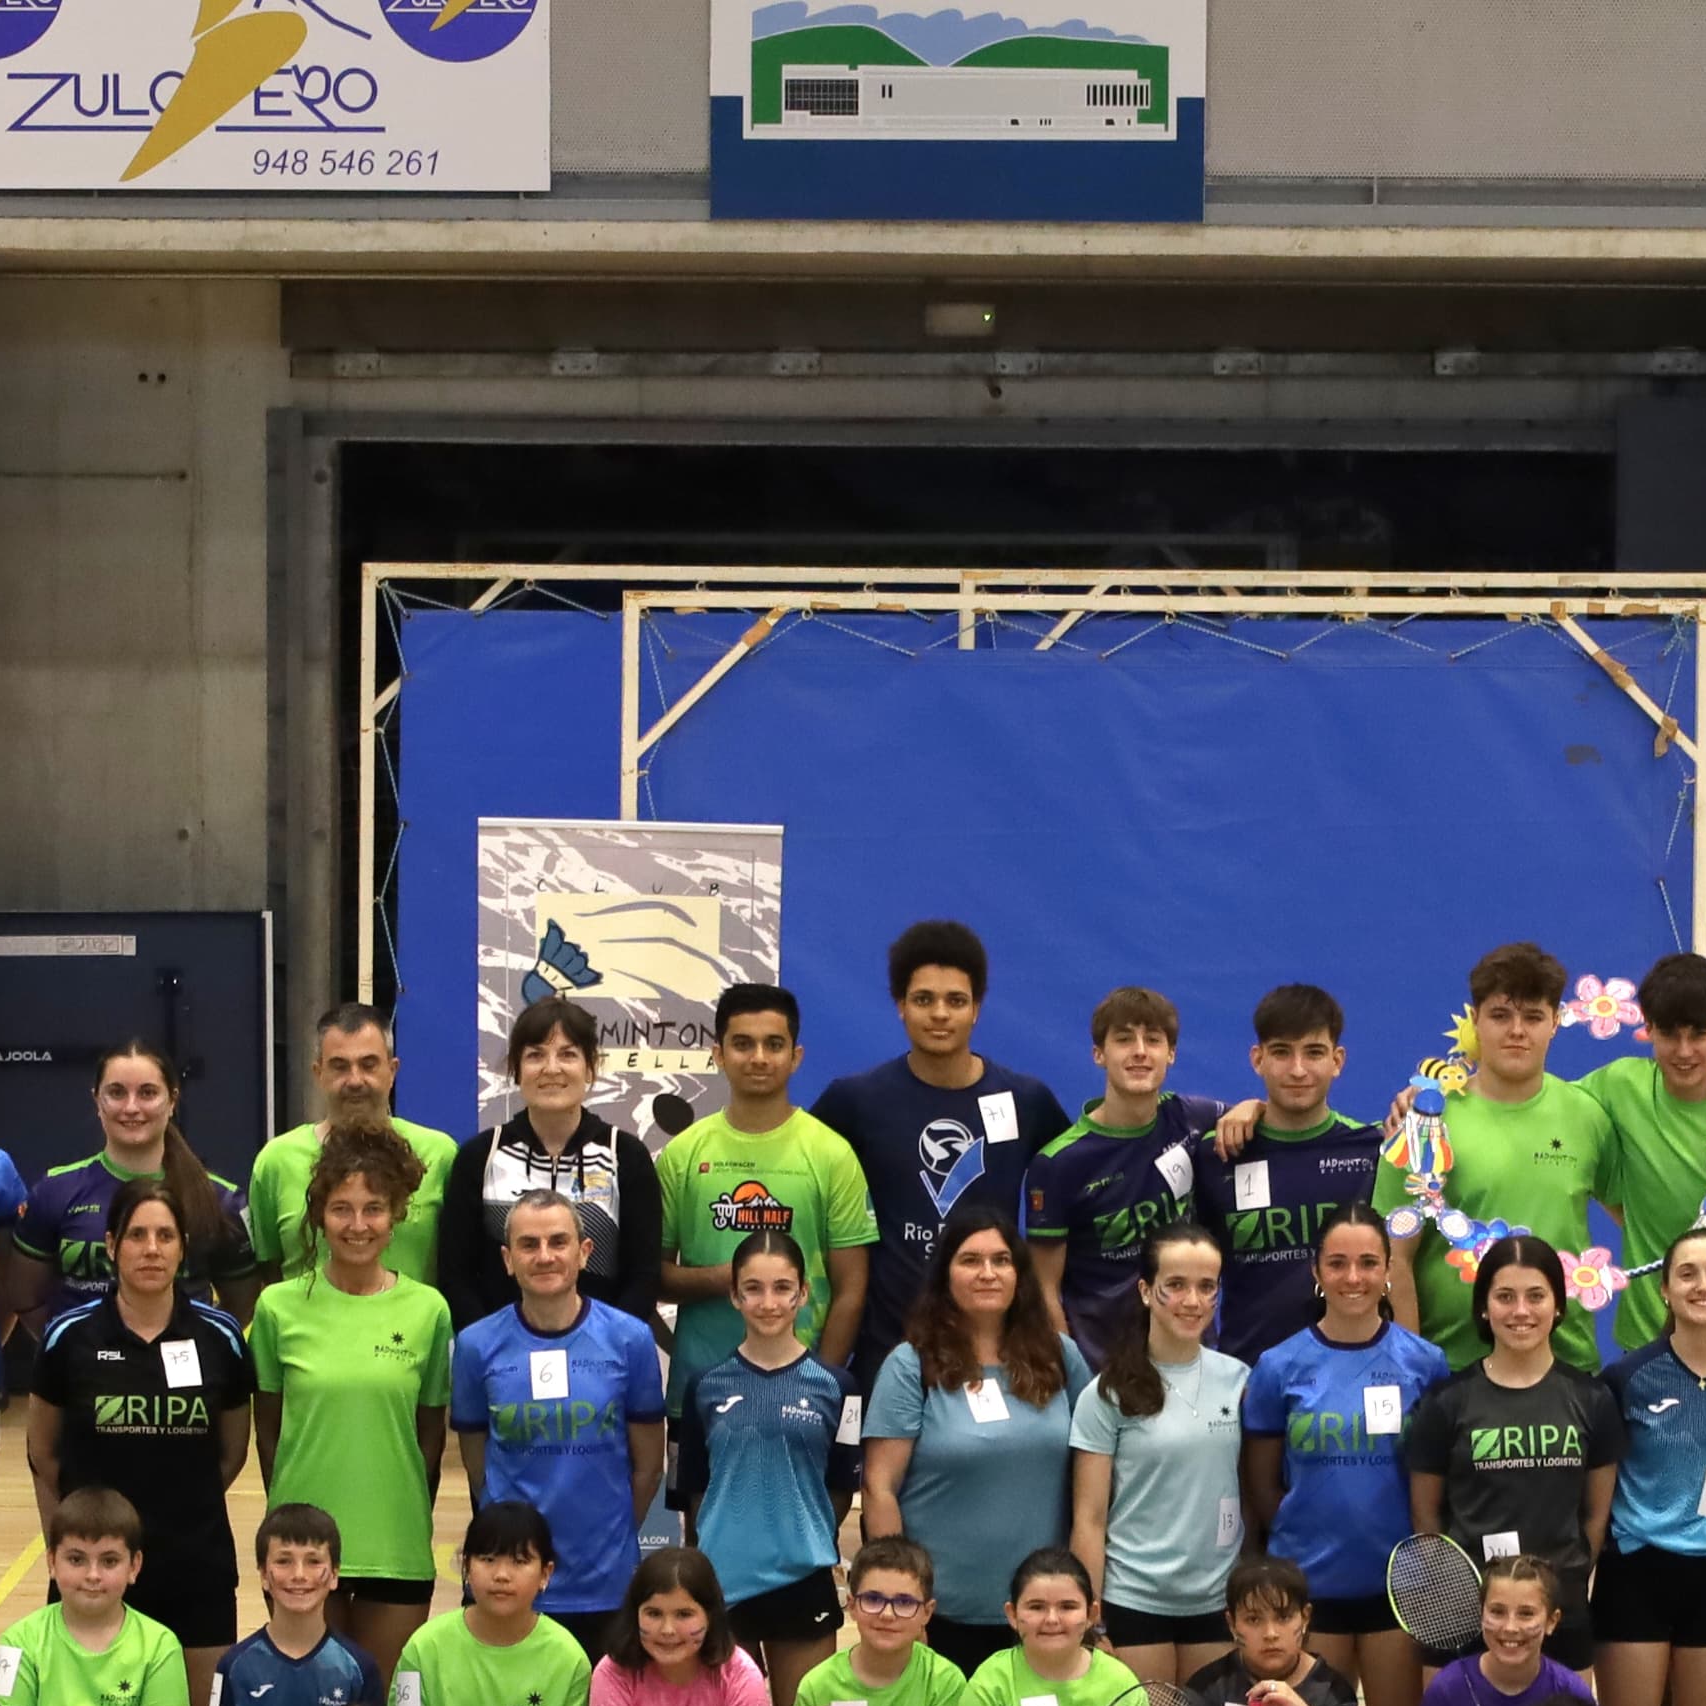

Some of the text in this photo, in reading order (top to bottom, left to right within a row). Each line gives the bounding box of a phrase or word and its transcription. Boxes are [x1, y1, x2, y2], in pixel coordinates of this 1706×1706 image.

[252, 148, 441, 176] 948 546 261
[537, 878, 720, 896] CLUB
[599, 1021, 718, 1048] MINTON
[5, 1050, 52, 1061] JOOLA
[598, 1052, 715, 1070] TELLA
[1243, 1172, 1255, 1197] 1
[737, 1208, 790, 1224] HILL HALF
[97, 1350, 126, 1361] RSL
[539, 1361, 553, 1383] 6
[128, 1395, 210, 1426] RIPA
[1373, 1399, 1394, 1417] 15
[523, 1400, 618, 1441] RIPA
[96, 1425, 157, 1435] TRANSPORTES
[1505, 1424, 1582, 1457] RIPA
[1474, 1459, 1535, 1471] TRANSPORTES
[1535, 1458, 1542, 1467] Y
[638, 1535, 670, 1545] LA.COM
